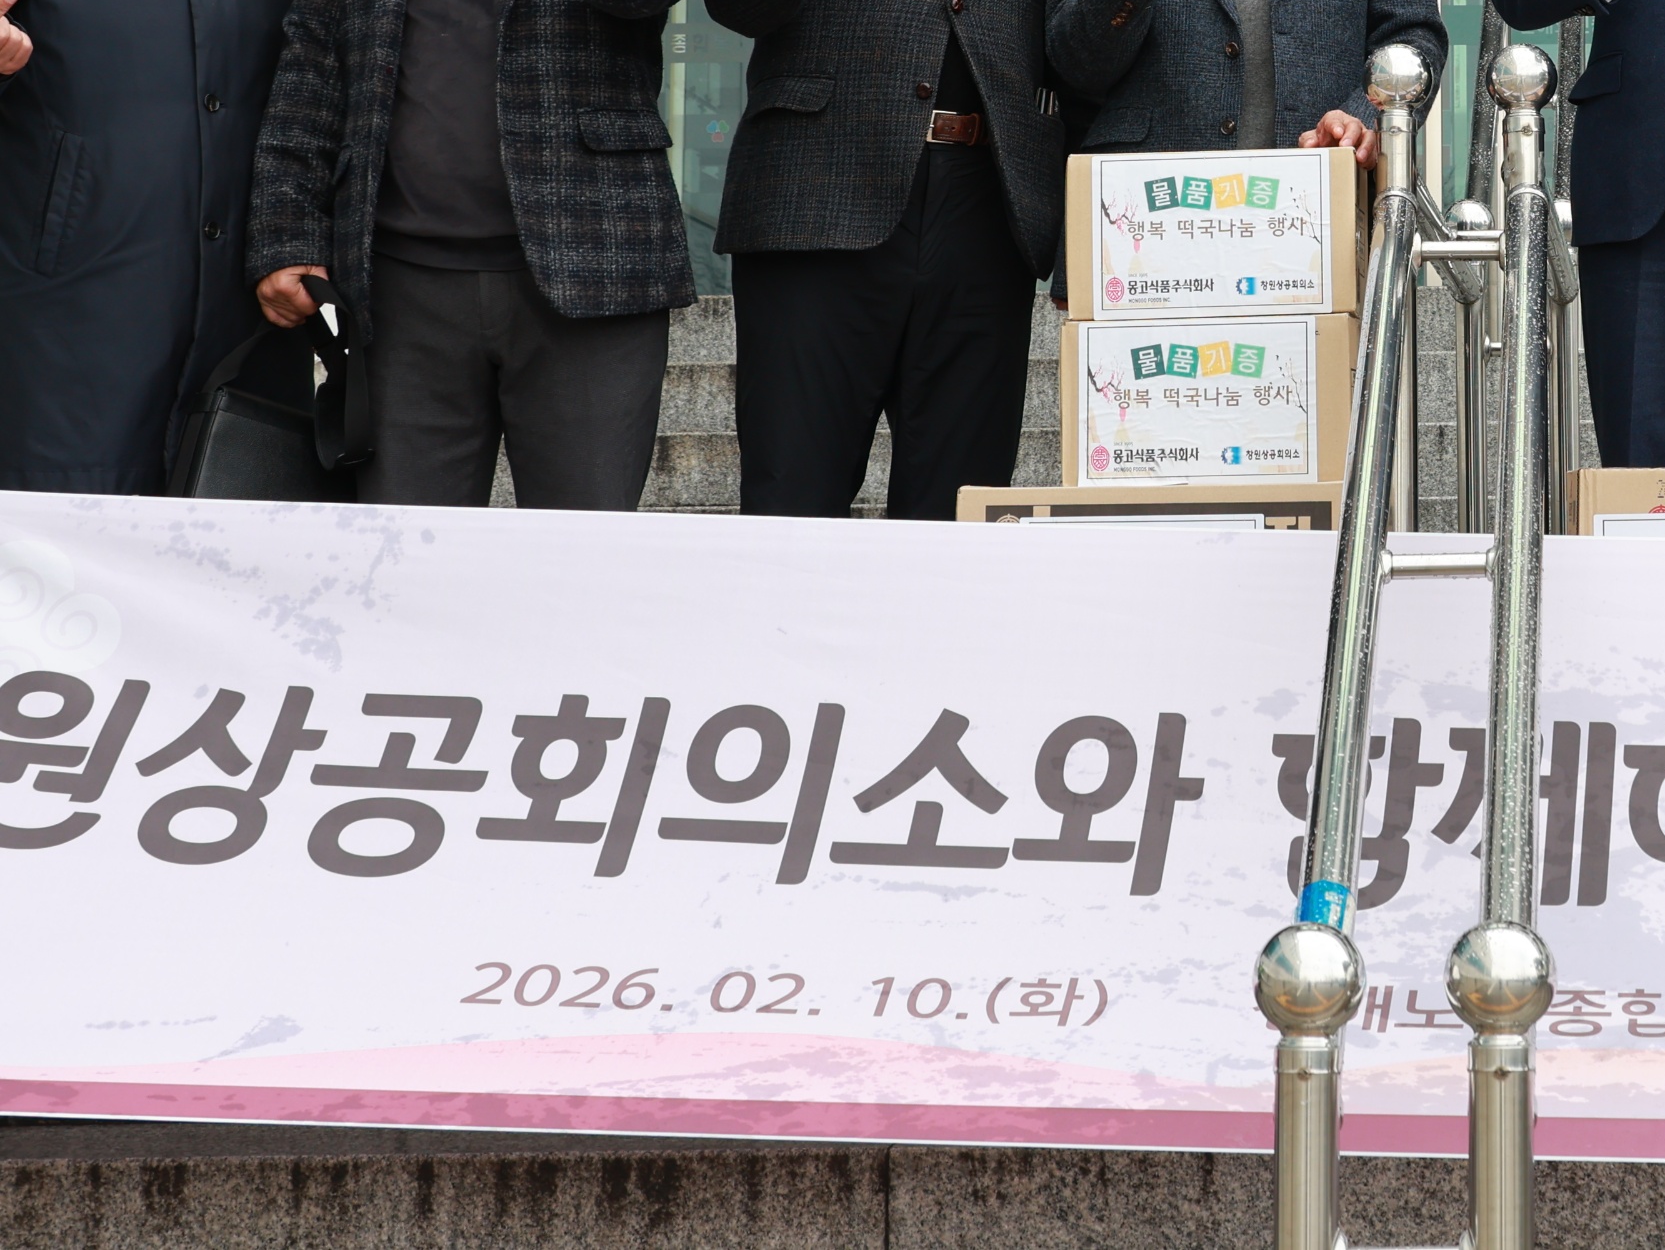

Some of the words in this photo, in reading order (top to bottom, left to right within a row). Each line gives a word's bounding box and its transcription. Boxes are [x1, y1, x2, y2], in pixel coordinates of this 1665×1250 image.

[1150, 177, 1275, 209] 물품기증
[1126, 219, 1167, 241] 행복
[1177, 218, 1257, 240] 떡국나눔
[1266, 216, 1306, 237] 행사
[1127, 278, 1215, 296] 몽고식품주식회사
[1260, 279, 1315, 291] 창원상공회의소
[1136, 346, 1260, 377] 물품기증
[1113, 388, 1152, 409] 행복
[1163, 386, 1243, 408] 떡국나눔
[1253, 385, 1293, 406] 행사
[1113, 447, 1200, 464] 몽고식품주식회사
[1245, 448, 1300, 461] 창원상공회의소
[459, 960, 675, 1012] 2026.
[709, 970, 822, 1017] 02.
[868, 976, 1110, 1028] 10.(화)
